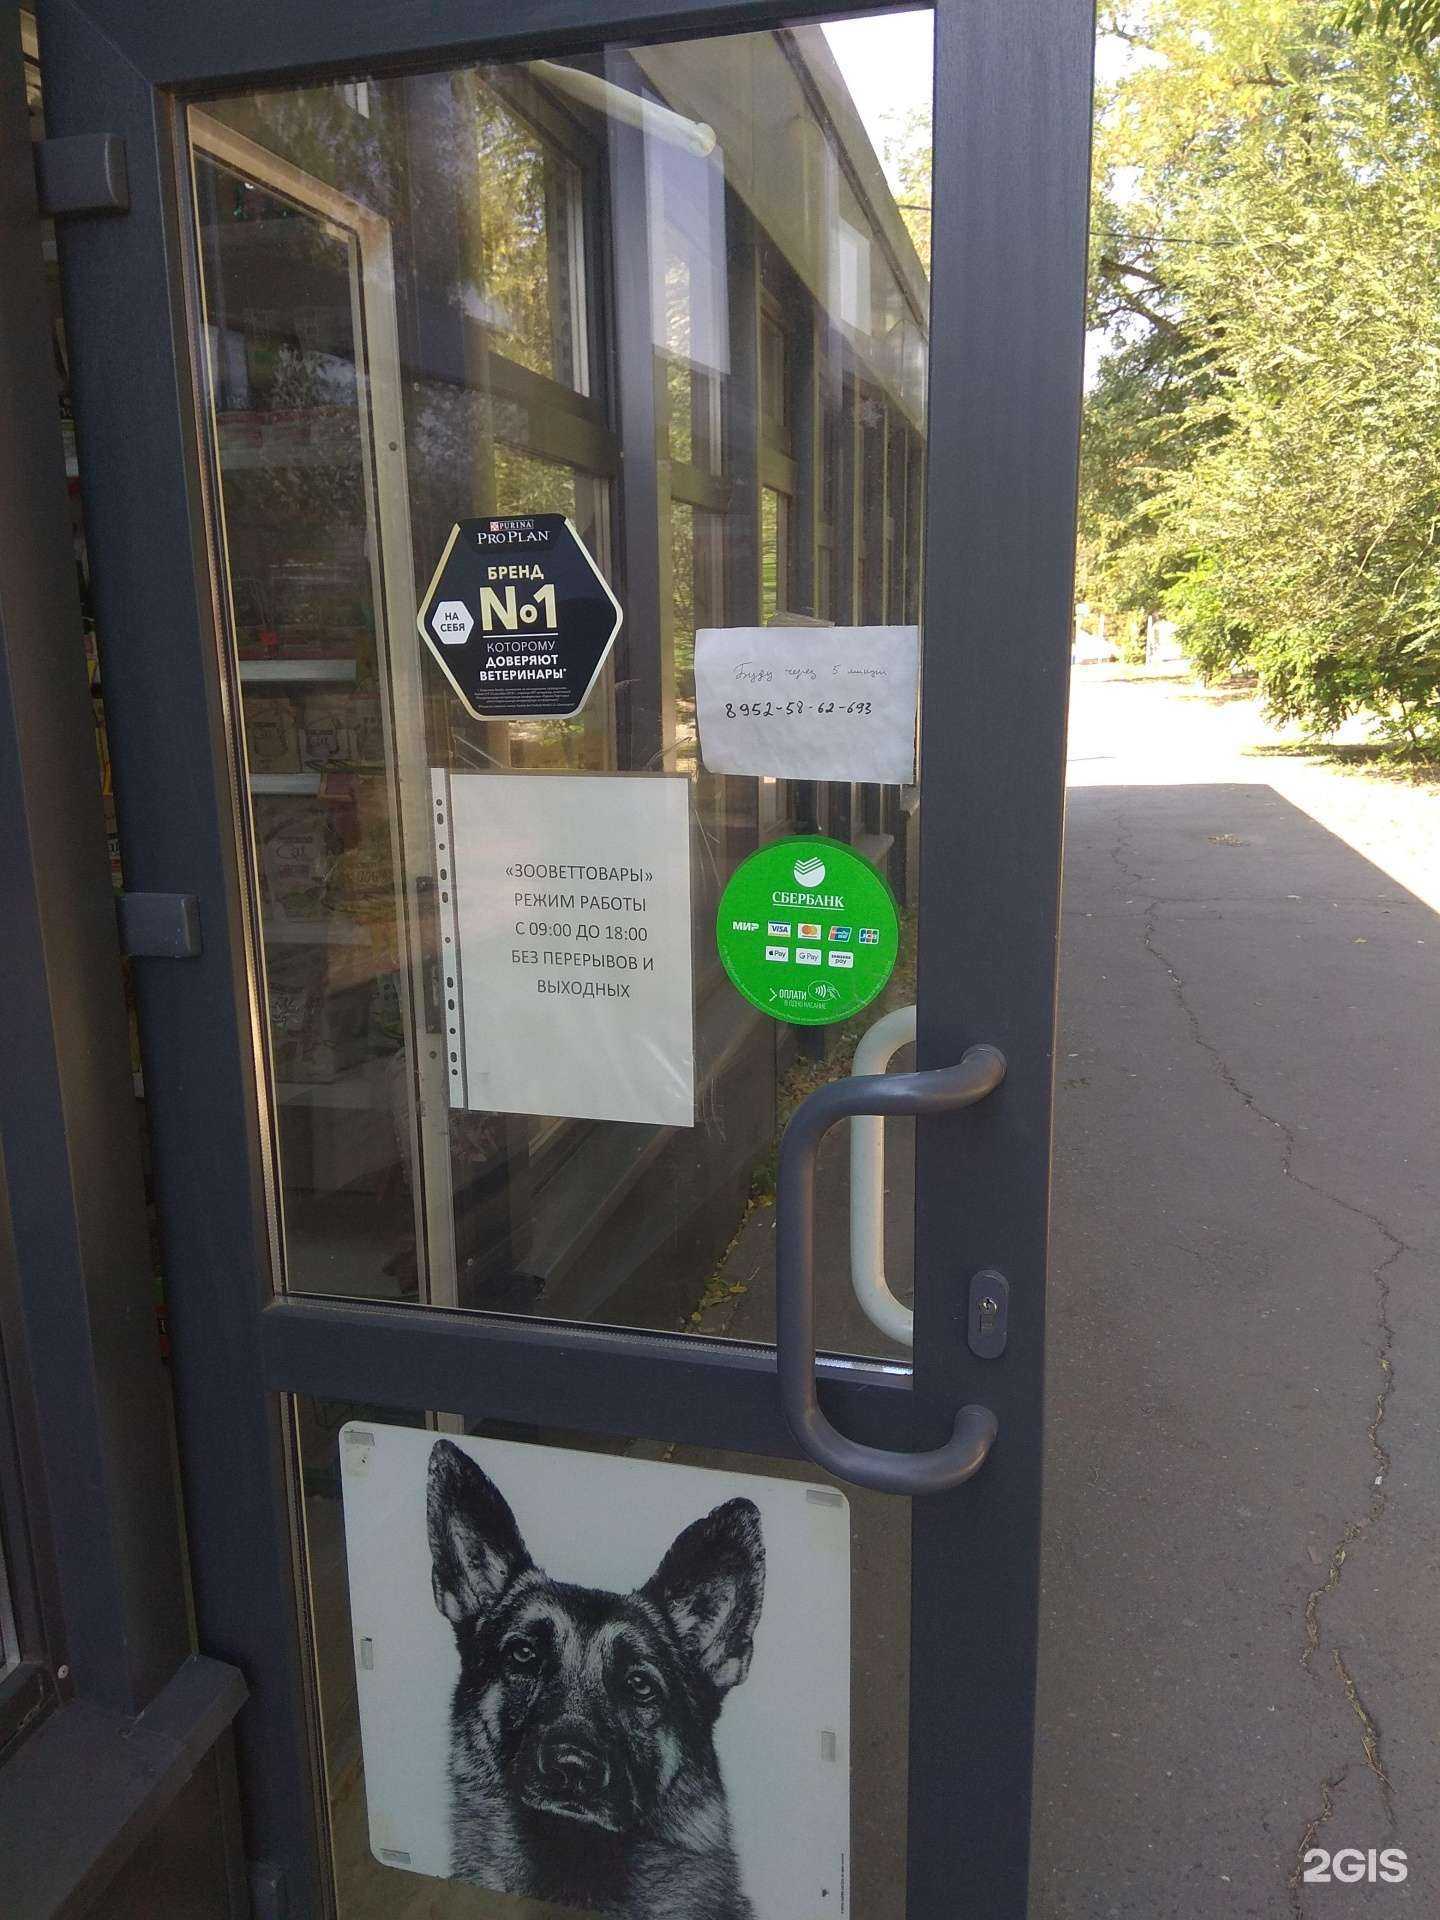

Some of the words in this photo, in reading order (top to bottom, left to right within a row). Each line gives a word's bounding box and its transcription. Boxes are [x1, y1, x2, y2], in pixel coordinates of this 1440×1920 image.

[499, 520, 531, 530] PURINA
[487, 564, 544, 580] БРЕНД
[444, 612, 459, 621] НА
[440, 623, 465, 632] СЕБЯ
[487, 641, 556, 652] КОТОРОМУ
[485, 654, 558, 668] ДОВЕРЯЮТ
[733, 661, 773, 682] Буду
[832, 664, 842, 676] 5
[505, 863, 653, 882] «ЗООВЕТТОВАРЫ»
[514, 892, 575, 908] РЕЖИМ
[580, 895, 646, 912] РАБОТЫ
[772, 891, 845, 908] СБЕРБАНК
[515, 922, 525, 935] С
[529, 922, 572, 937] 09:00
[575, 924, 600, 941] ДО
[605, 926, 648, 941] 18:00
[733, 921, 760, 932] МИР
[771, 925, 789, 933] VISA
[511, 950, 538, 964] БЕЗ
[543, 952, 638, 970] ПЕРЕРЫВОВ
[643, 957, 654, 971] И
[774, 950, 787, 959] Pay
[537, 979, 631, 998] ВЫХОДНЫХ
[779, 988, 807, 1000] ОПЛАТИ
